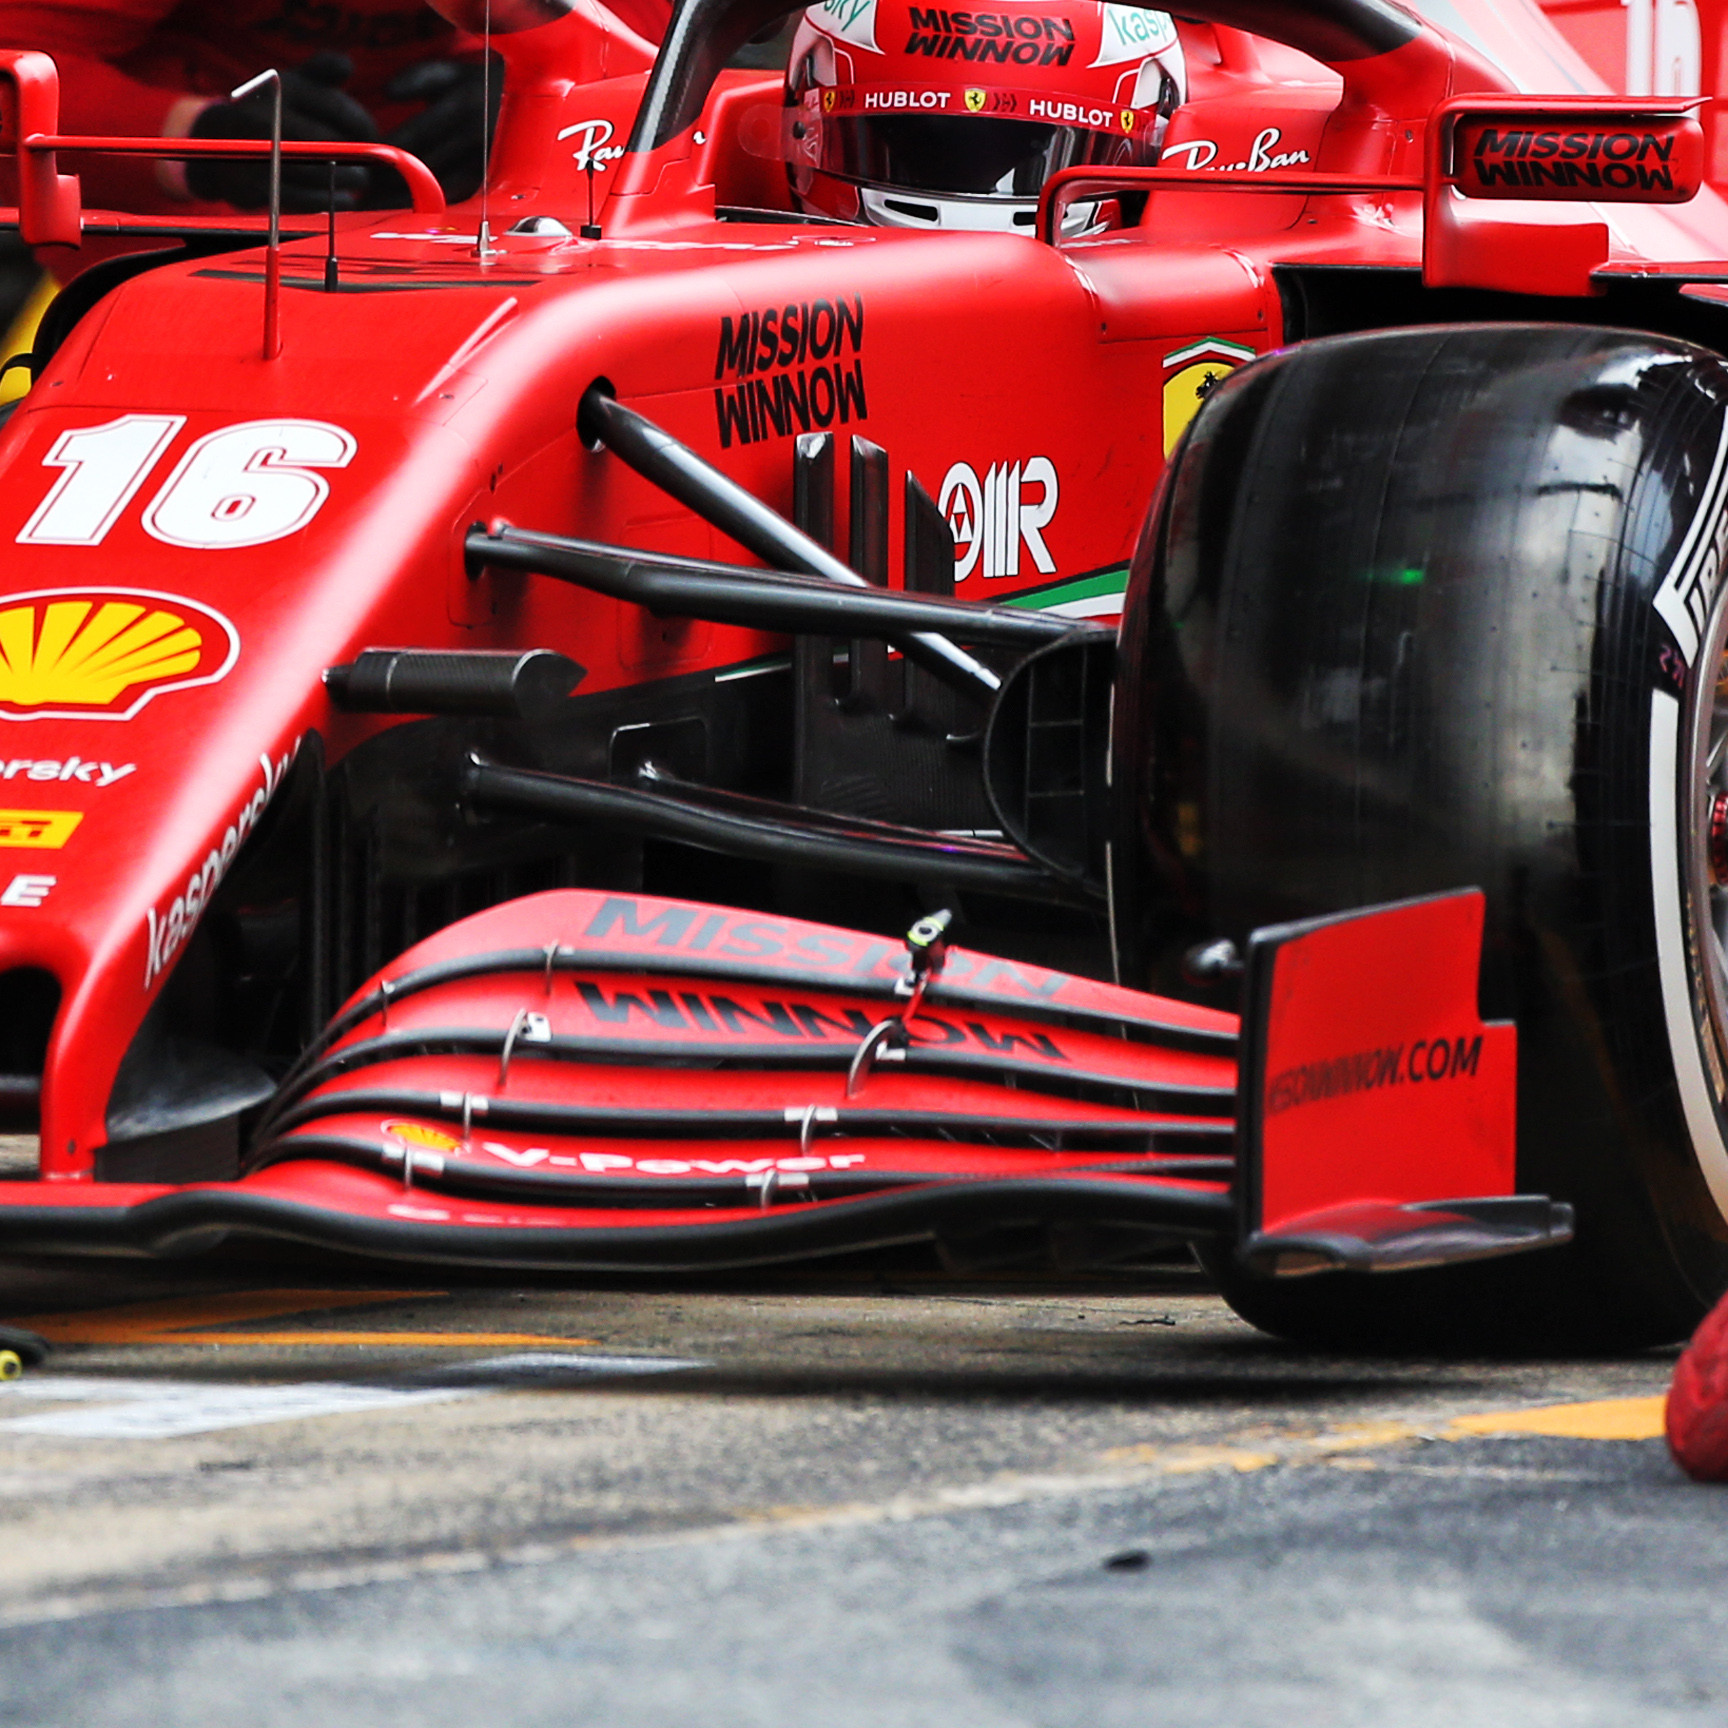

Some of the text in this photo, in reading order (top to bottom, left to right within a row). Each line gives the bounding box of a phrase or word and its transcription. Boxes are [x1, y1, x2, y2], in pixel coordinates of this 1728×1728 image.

[908, 6, 1075, 42] MISSION
[904, 31, 1074, 68] WINNOW
[865, 91, 952, 109] HUBLOT
[1029, 98, 1114, 128] HUBLOT
[1474, 128, 1675, 162] MISSION
[1475, 158, 1674, 192] WINNOW
[714, 292, 865, 380] MISSION
[714, 358, 868, 450] WINNOW
[15, 414, 359, 550] 16
